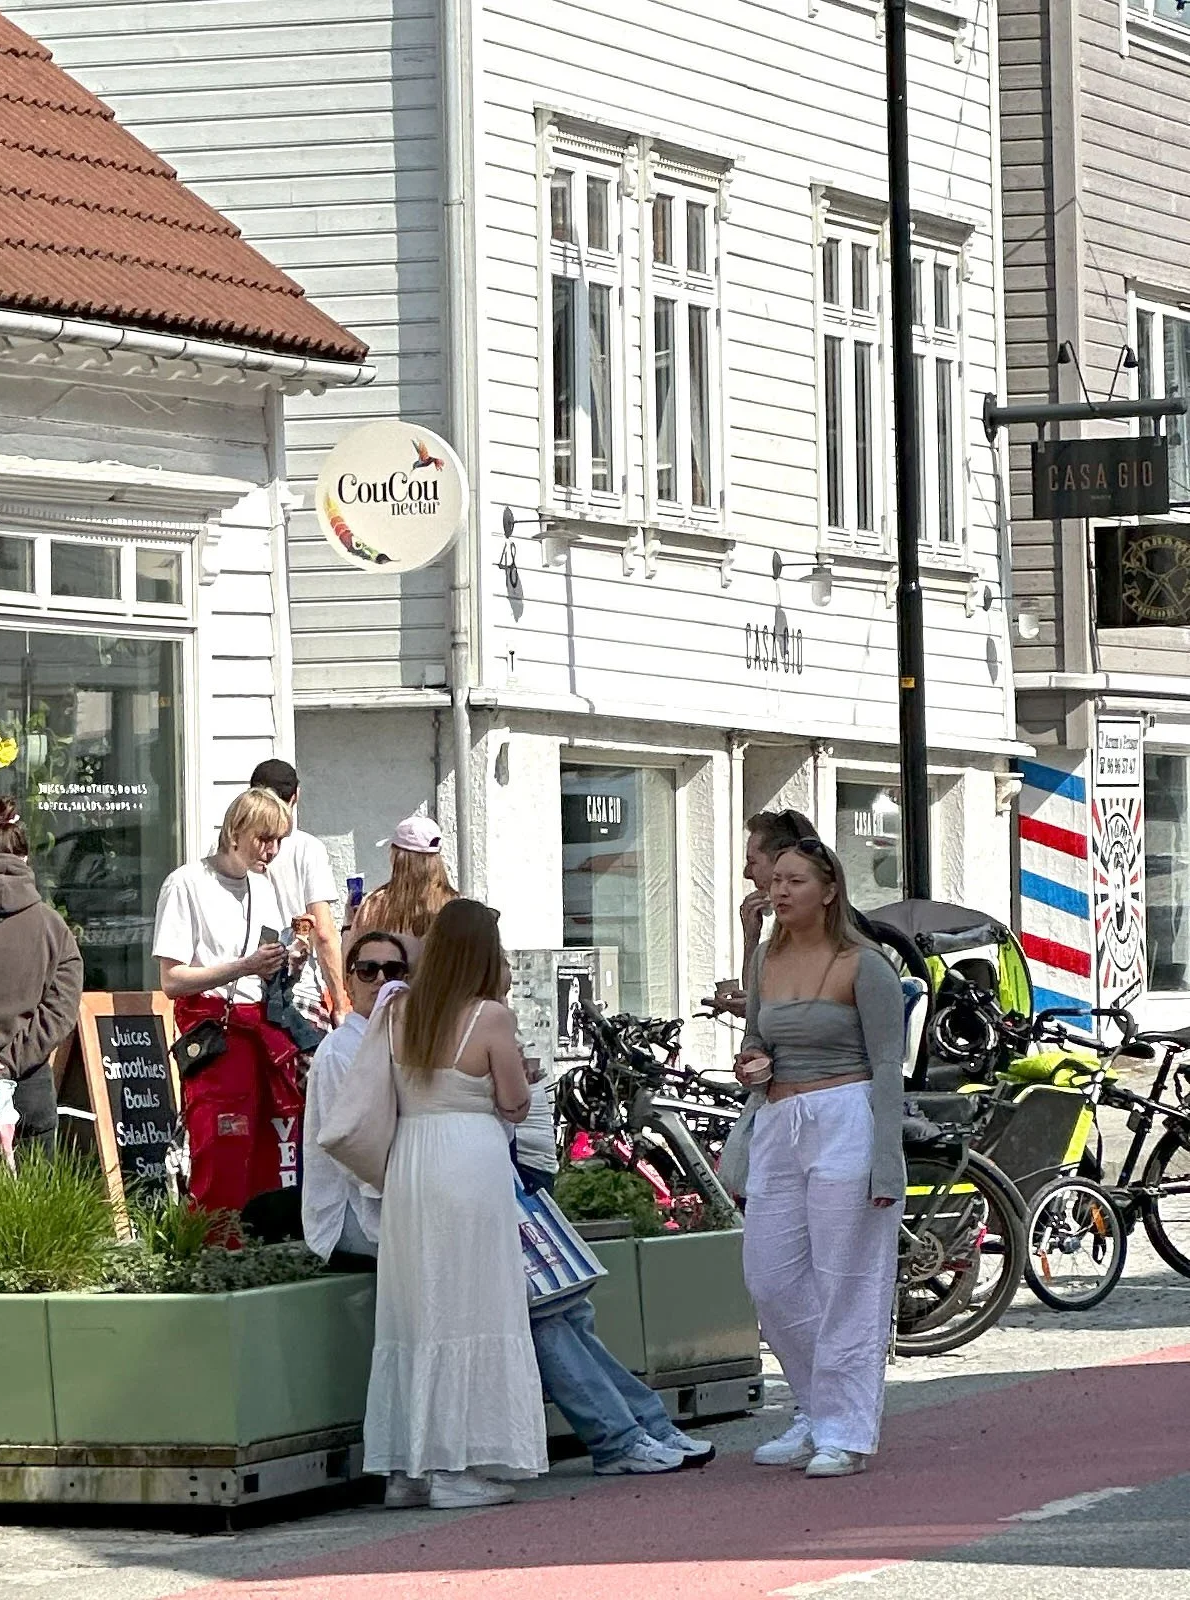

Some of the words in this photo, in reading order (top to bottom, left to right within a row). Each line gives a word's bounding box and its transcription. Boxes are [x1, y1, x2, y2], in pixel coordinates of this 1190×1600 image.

[337, 471, 440, 505] CouCou
[1048, 462, 1108, 492] CASA
[1117, 460, 1153, 489] GIO
[390, 501, 440, 516] nectar
[745, 622, 779, 673] CASA
[783, 627, 803, 675] GIO
[586, 795, 607, 823] CASA
[608, 796, 621, 824] GIO
[111, 1024, 152, 1047] Juices
[102, 1055, 167, 1080] Smoothies
[123, 1086, 160, 1109] Bowls
[116, 1120, 147, 1147] Salad
